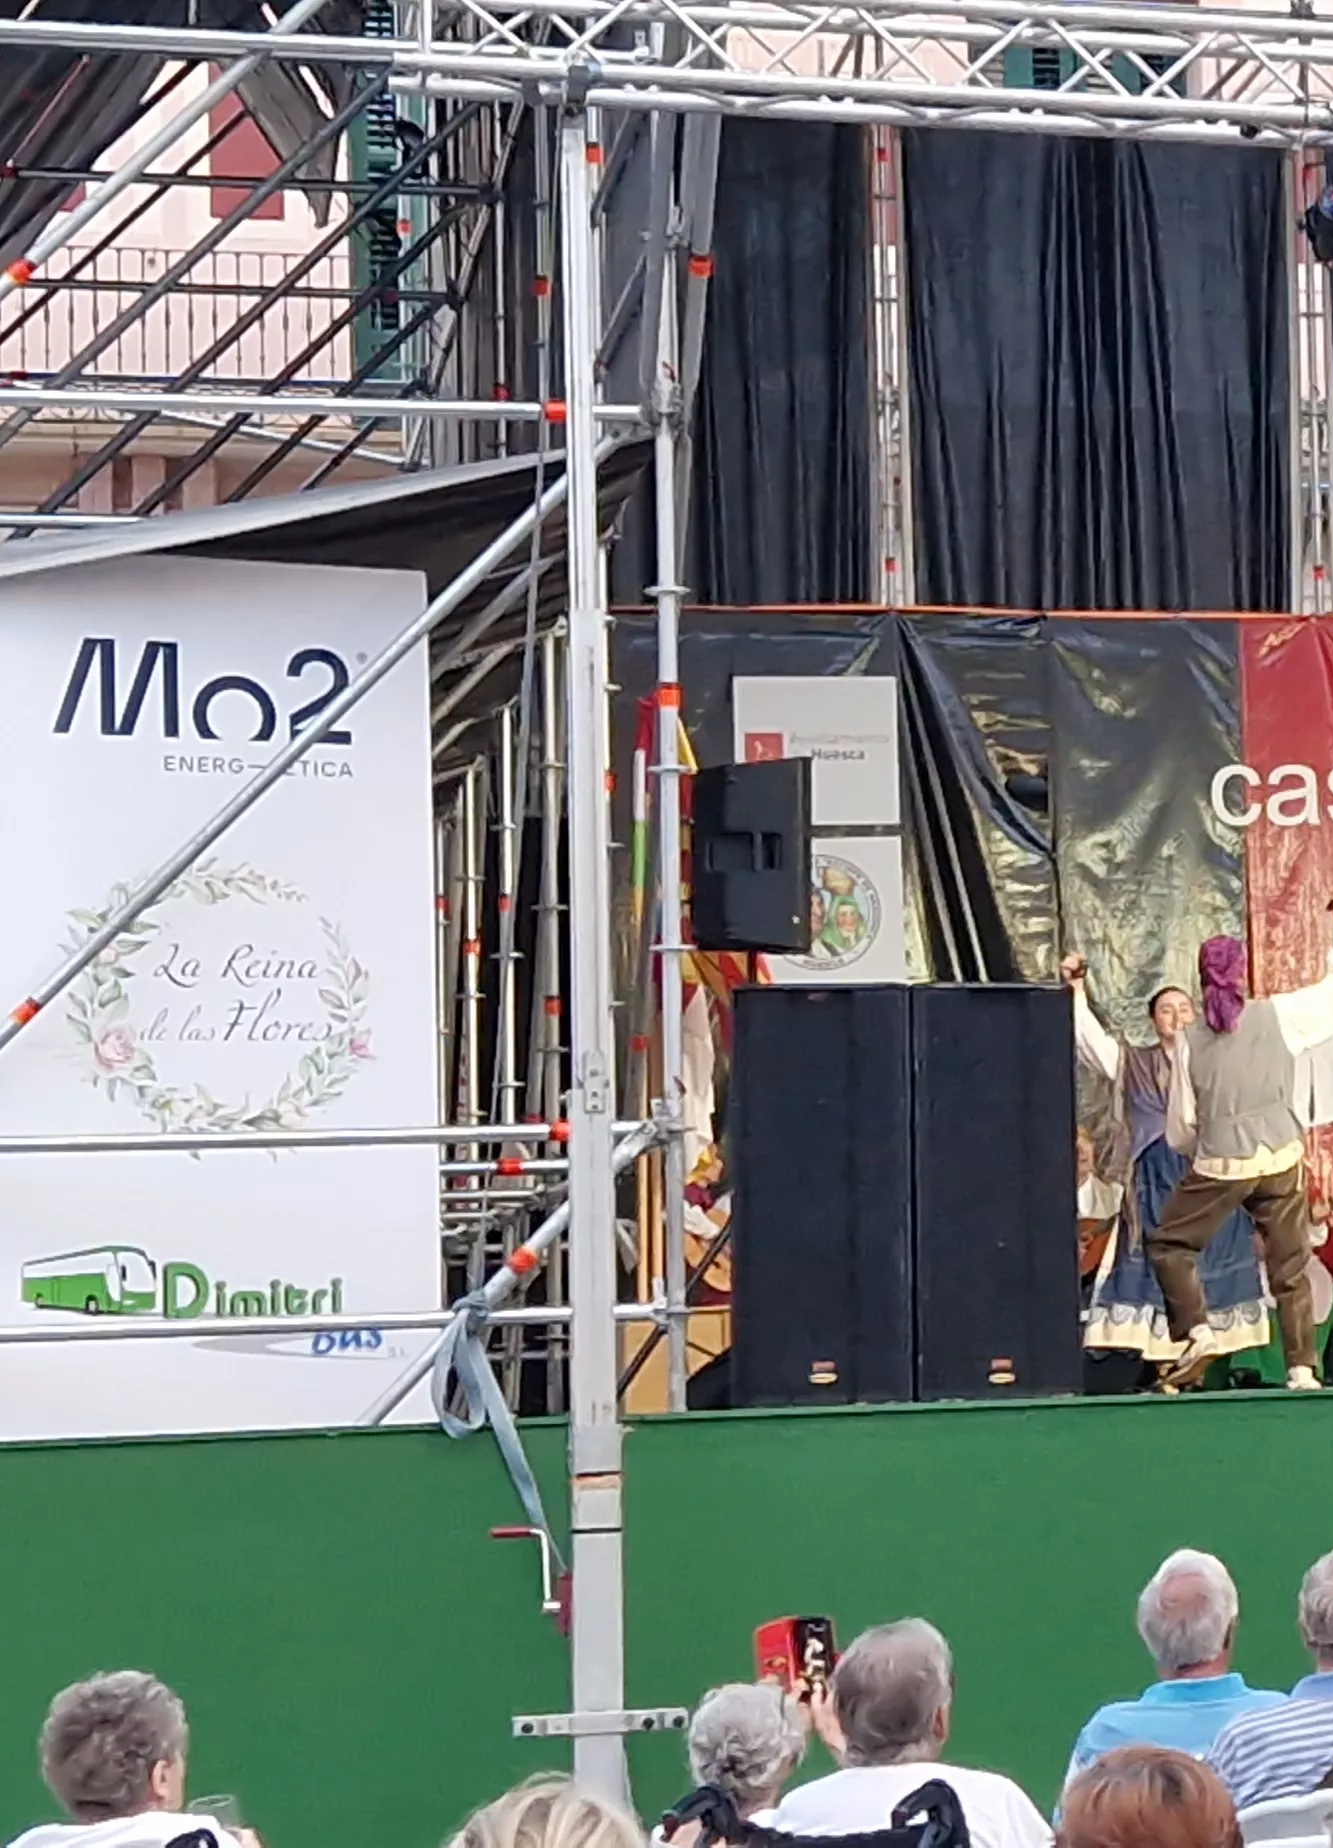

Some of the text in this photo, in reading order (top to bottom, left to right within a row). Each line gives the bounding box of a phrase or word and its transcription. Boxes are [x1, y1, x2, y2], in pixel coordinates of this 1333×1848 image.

[53, 637, 352, 745] Mo2
[153, 942, 318, 989] La Reina
[139, 986, 333, 1042] de las Flores
[163, 1261, 343, 1320] Dimitri
